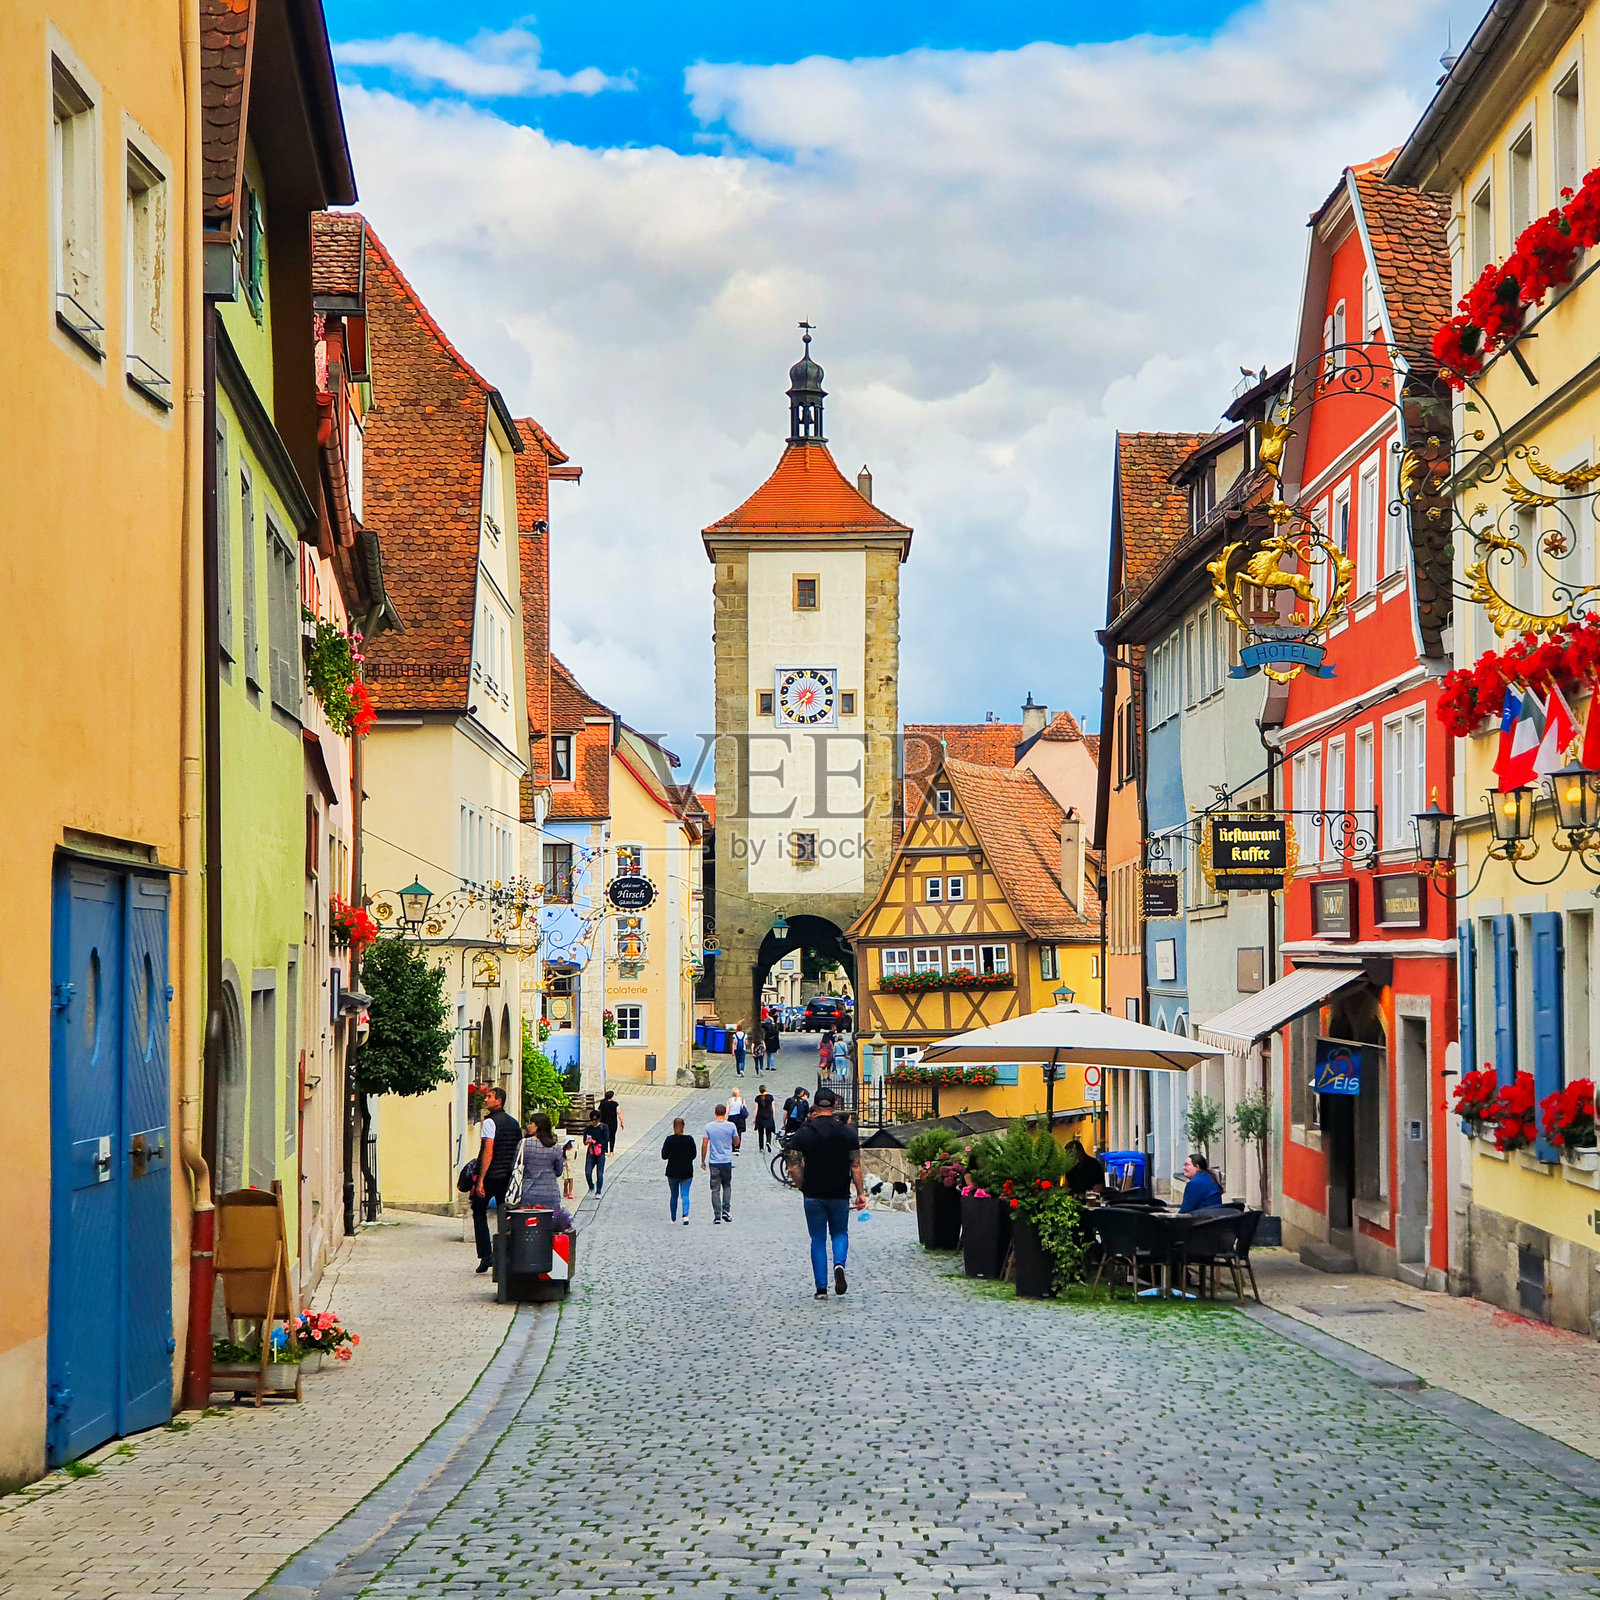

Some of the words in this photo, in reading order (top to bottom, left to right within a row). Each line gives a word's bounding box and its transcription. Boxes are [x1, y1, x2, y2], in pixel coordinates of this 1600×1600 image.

[1256, 645, 1310, 661] HOTEL
[1231, 846, 1271, 862] Kaffee
[616, 889, 646, 899] Hirsch
[1333, 1077, 1360, 1091] EIS
